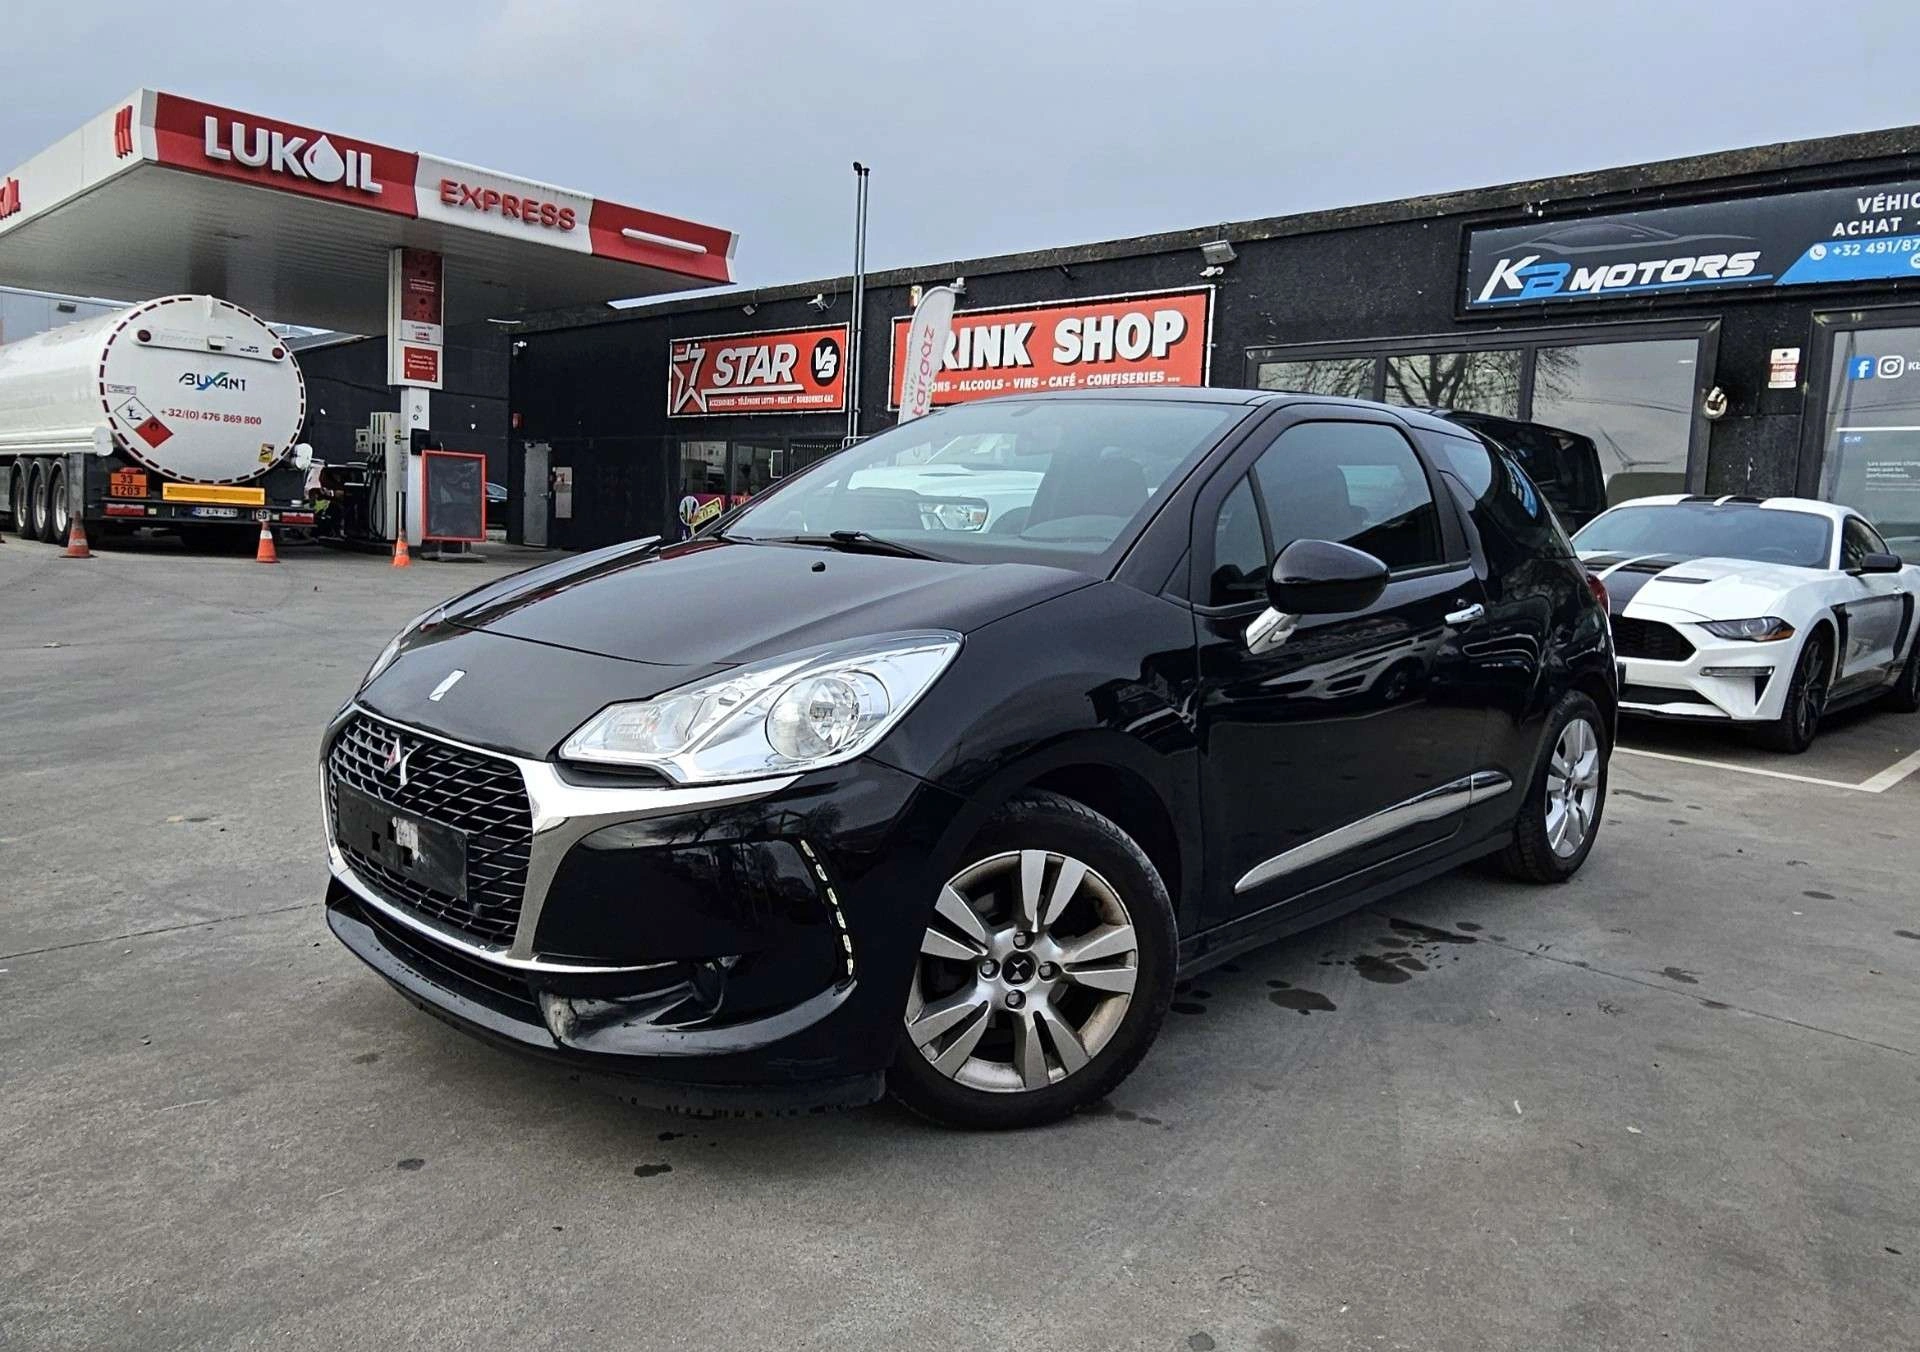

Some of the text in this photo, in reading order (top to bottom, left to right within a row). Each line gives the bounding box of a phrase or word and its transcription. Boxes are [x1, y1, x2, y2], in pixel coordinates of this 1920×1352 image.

[205, 115, 383, 195] LUKOIL
[439, 178, 577, 231] EXPRESS
[1832, 216, 1903, 237] ACHAT
[1832, 243, 1861, 257] +32
[1478, 251, 1761, 301] KB MOTORS
[940, 309, 1185, 370] RINK SHOP
[712, 343, 798, 387] STAR
[959, 379, 1004, 392] ALCOOLS
[1013, 377, 1039, 390] VINS
[1049, 372, 1076, 388] CAFÉ
[1087, 370, 1165, 386] CONFISERIES
[202, 412, 221, 423] 476
[223, 413, 242, 424] 869
[244, 414, 262, 425] 800
[120, 474, 134, 485] 33
[114, 486, 141, 496] 1203
